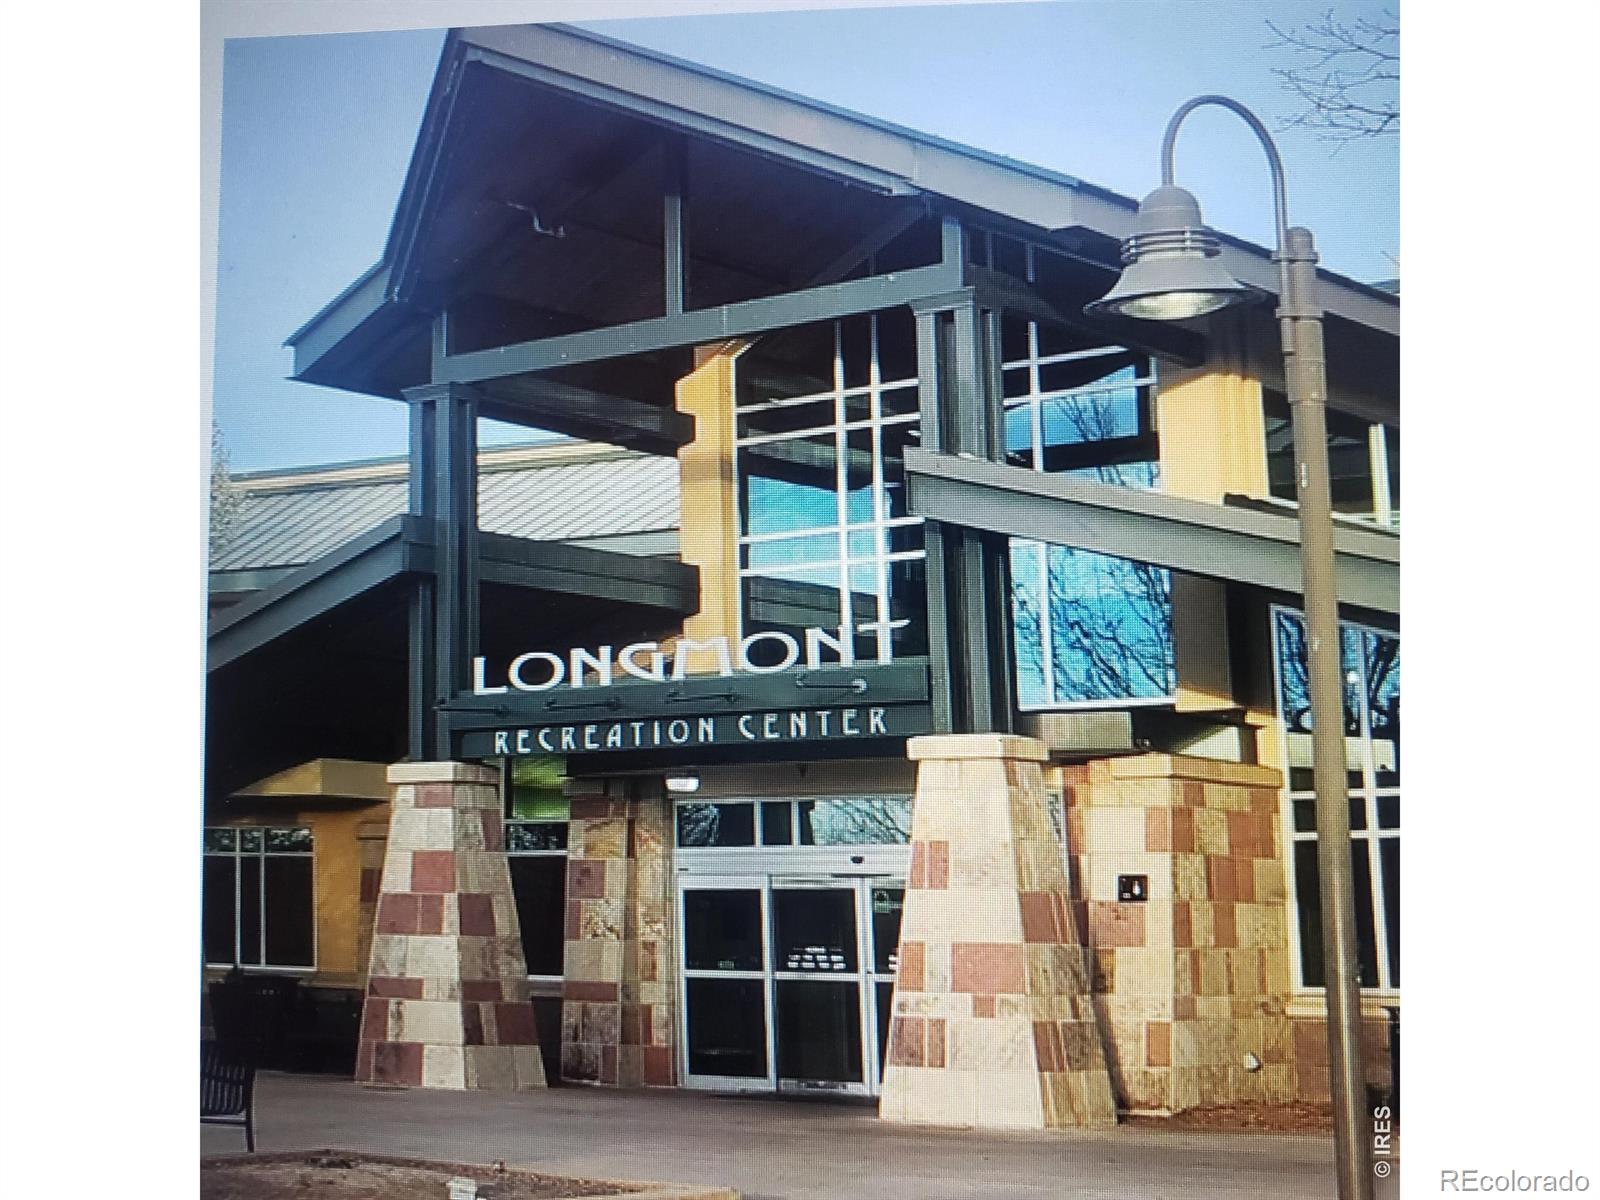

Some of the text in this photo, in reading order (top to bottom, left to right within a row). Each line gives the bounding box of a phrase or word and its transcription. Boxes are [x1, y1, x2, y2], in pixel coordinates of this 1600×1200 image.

[472, 619, 910, 696] LONGMONT
[494, 707, 887, 755] RECREATION CENTER
